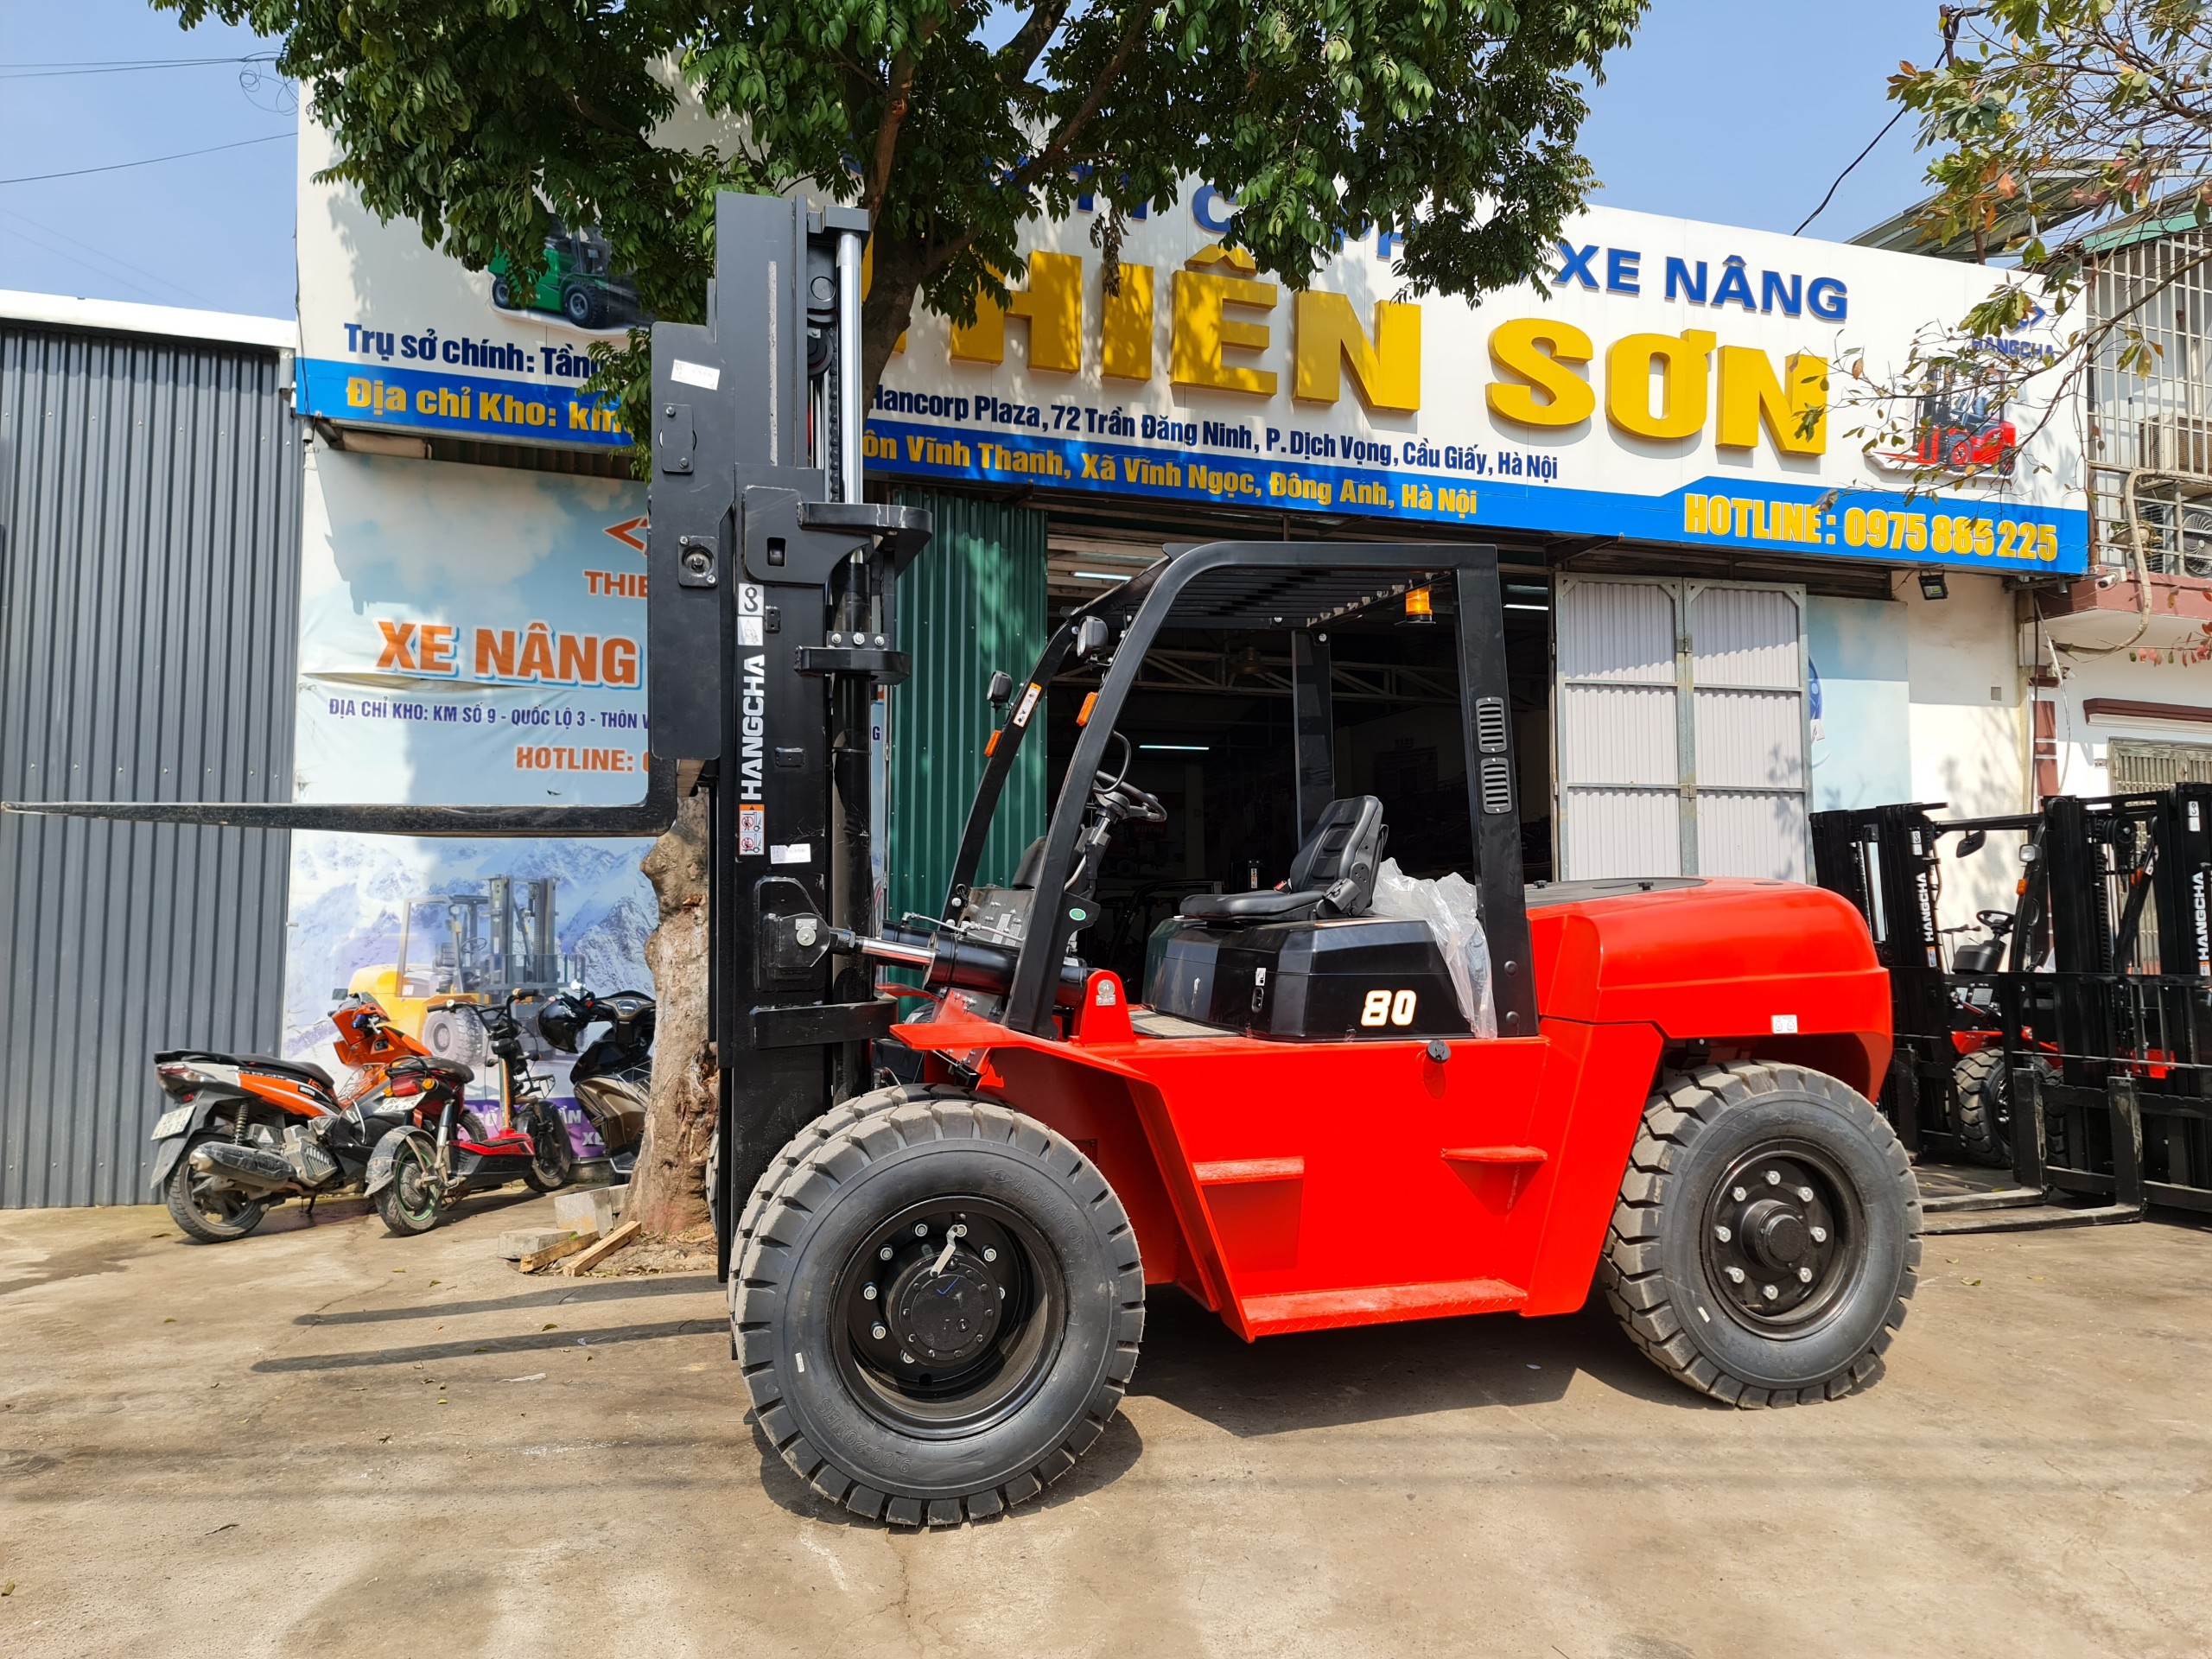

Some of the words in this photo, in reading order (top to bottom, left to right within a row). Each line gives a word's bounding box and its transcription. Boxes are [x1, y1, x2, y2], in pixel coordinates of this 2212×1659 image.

[1550, 240, 1641, 294] XE
[1665, 254, 1849, 321] NÂNG
[862, 232, 1421, 413] HIÊN
[1484, 317, 1828, 456] SƠN
[1971, 336, 2055, 359] HANGCHA
[344, 322, 395, 361] Trụ
[401, 327, 438, 361] sở
[442, 337, 535, 373] chính:
[871, 384, 969, 422] Hancorp
[1084, 406, 1135, 438] Trần
[1141, 414, 1198, 447] Đăng
[1290, 430, 1337, 461] Dịch
[1339, 435, 1399, 467] Vọng,
[1402, 437, 1440, 468] Cầu
[1444, 443, 1494, 476] Giấy,
[1497, 451, 1522, 476] Hà
[1526, 454, 1558, 484] Nội
[346, 376, 407, 416] Địa
[416, 385, 472, 419] chỉ
[480, 391, 556, 427] Kho:
[906, 435, 971, 468] Vĩnh
[977, 442, 1071, 480] Thanh,
[1080, 452, 1116, 481] Xã
[1123, 457, 1181, 487] Vĩnh
[1188, 463, 1262, 499] Ngọc,
[1268, 471, 1332, 505] Đông
[1339, 479, 1395, 510] Anh,
[1401, 483, 1433, 511] Hà
[1438, 486, 1478, 518] Nội
[1844, 506, 1928, 552] 0975
[1997, 518, 2058, 562] 225
[375, 620, 455, 674] XE
[474, 621, 638, 685] NÂNG
[329, 698, 356, 719] ĐỊA
[361, 696, 388, 718] CHỈ
[392, 702, 428, 721] KHO:
[433, 705, 457, 722] KM
[462, 702, 484, 723] SỐ
[487, 709, 497, 724] 9
[512, 704, 550, 726] QUỐC
[555, 707, 572, 730] LỘ
[576, 710, 586, 727] 3
[600, 709, 638, 729] THÔN
[741, 654, 766, 801] HANGCHA
[516, 747, 633, 772] HOTLINE:
[1916, 871, 1935, 943] HANGCHA
[2192, 871, 2209, 961] HANGCHA
[1361, 989, 1417, 1027] 80
[1014, 1177, 1087, 1252] ADVANCE
